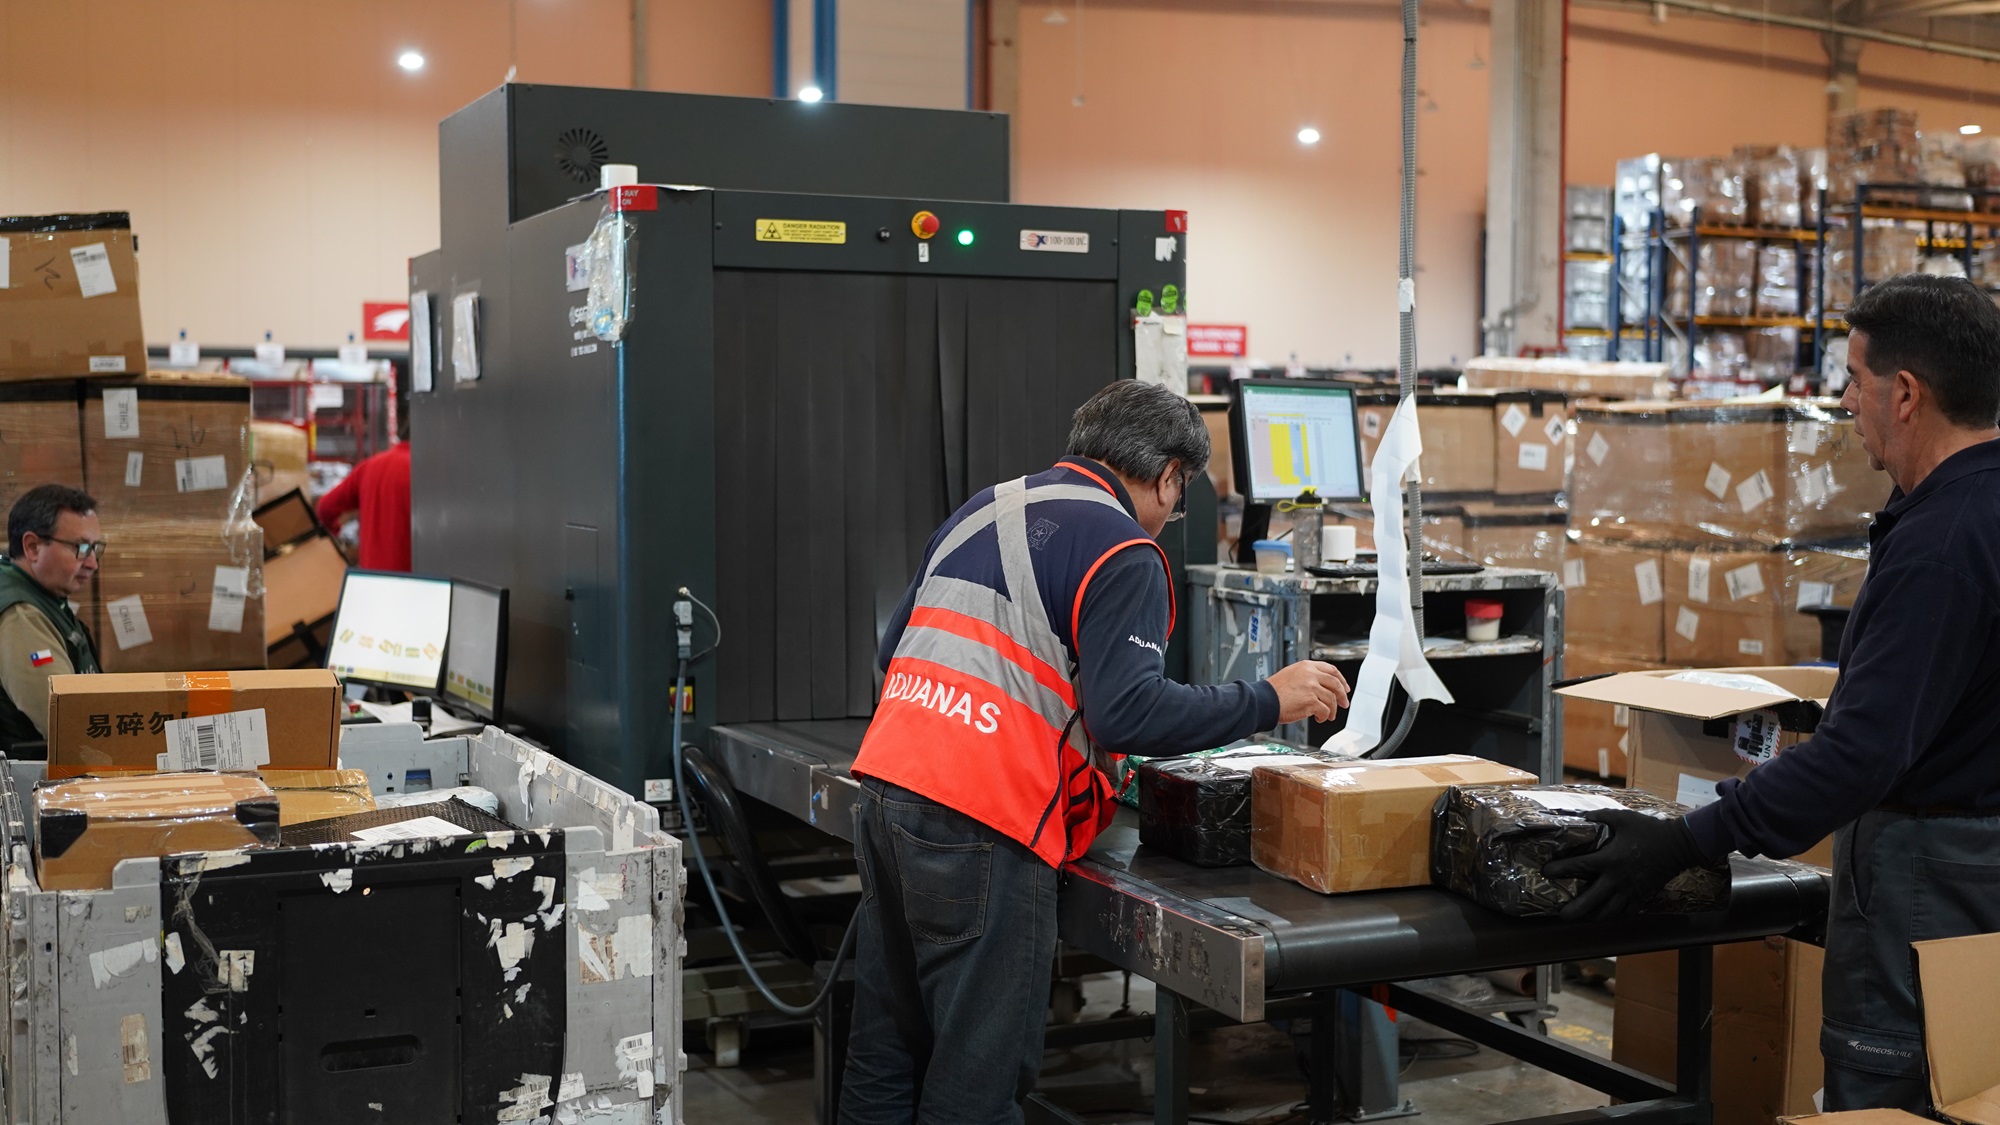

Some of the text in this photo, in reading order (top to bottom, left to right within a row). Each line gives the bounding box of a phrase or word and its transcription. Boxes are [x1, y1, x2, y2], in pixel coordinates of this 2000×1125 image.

[119, 401, 129, 432] CHILE
[1250, 615, 1259, 643] EMS
[884, 672, 1002, 734] ADUANAS
[86, 711, 189, 739] 易碎勿
[1763, 744, 1772, 759] UN
